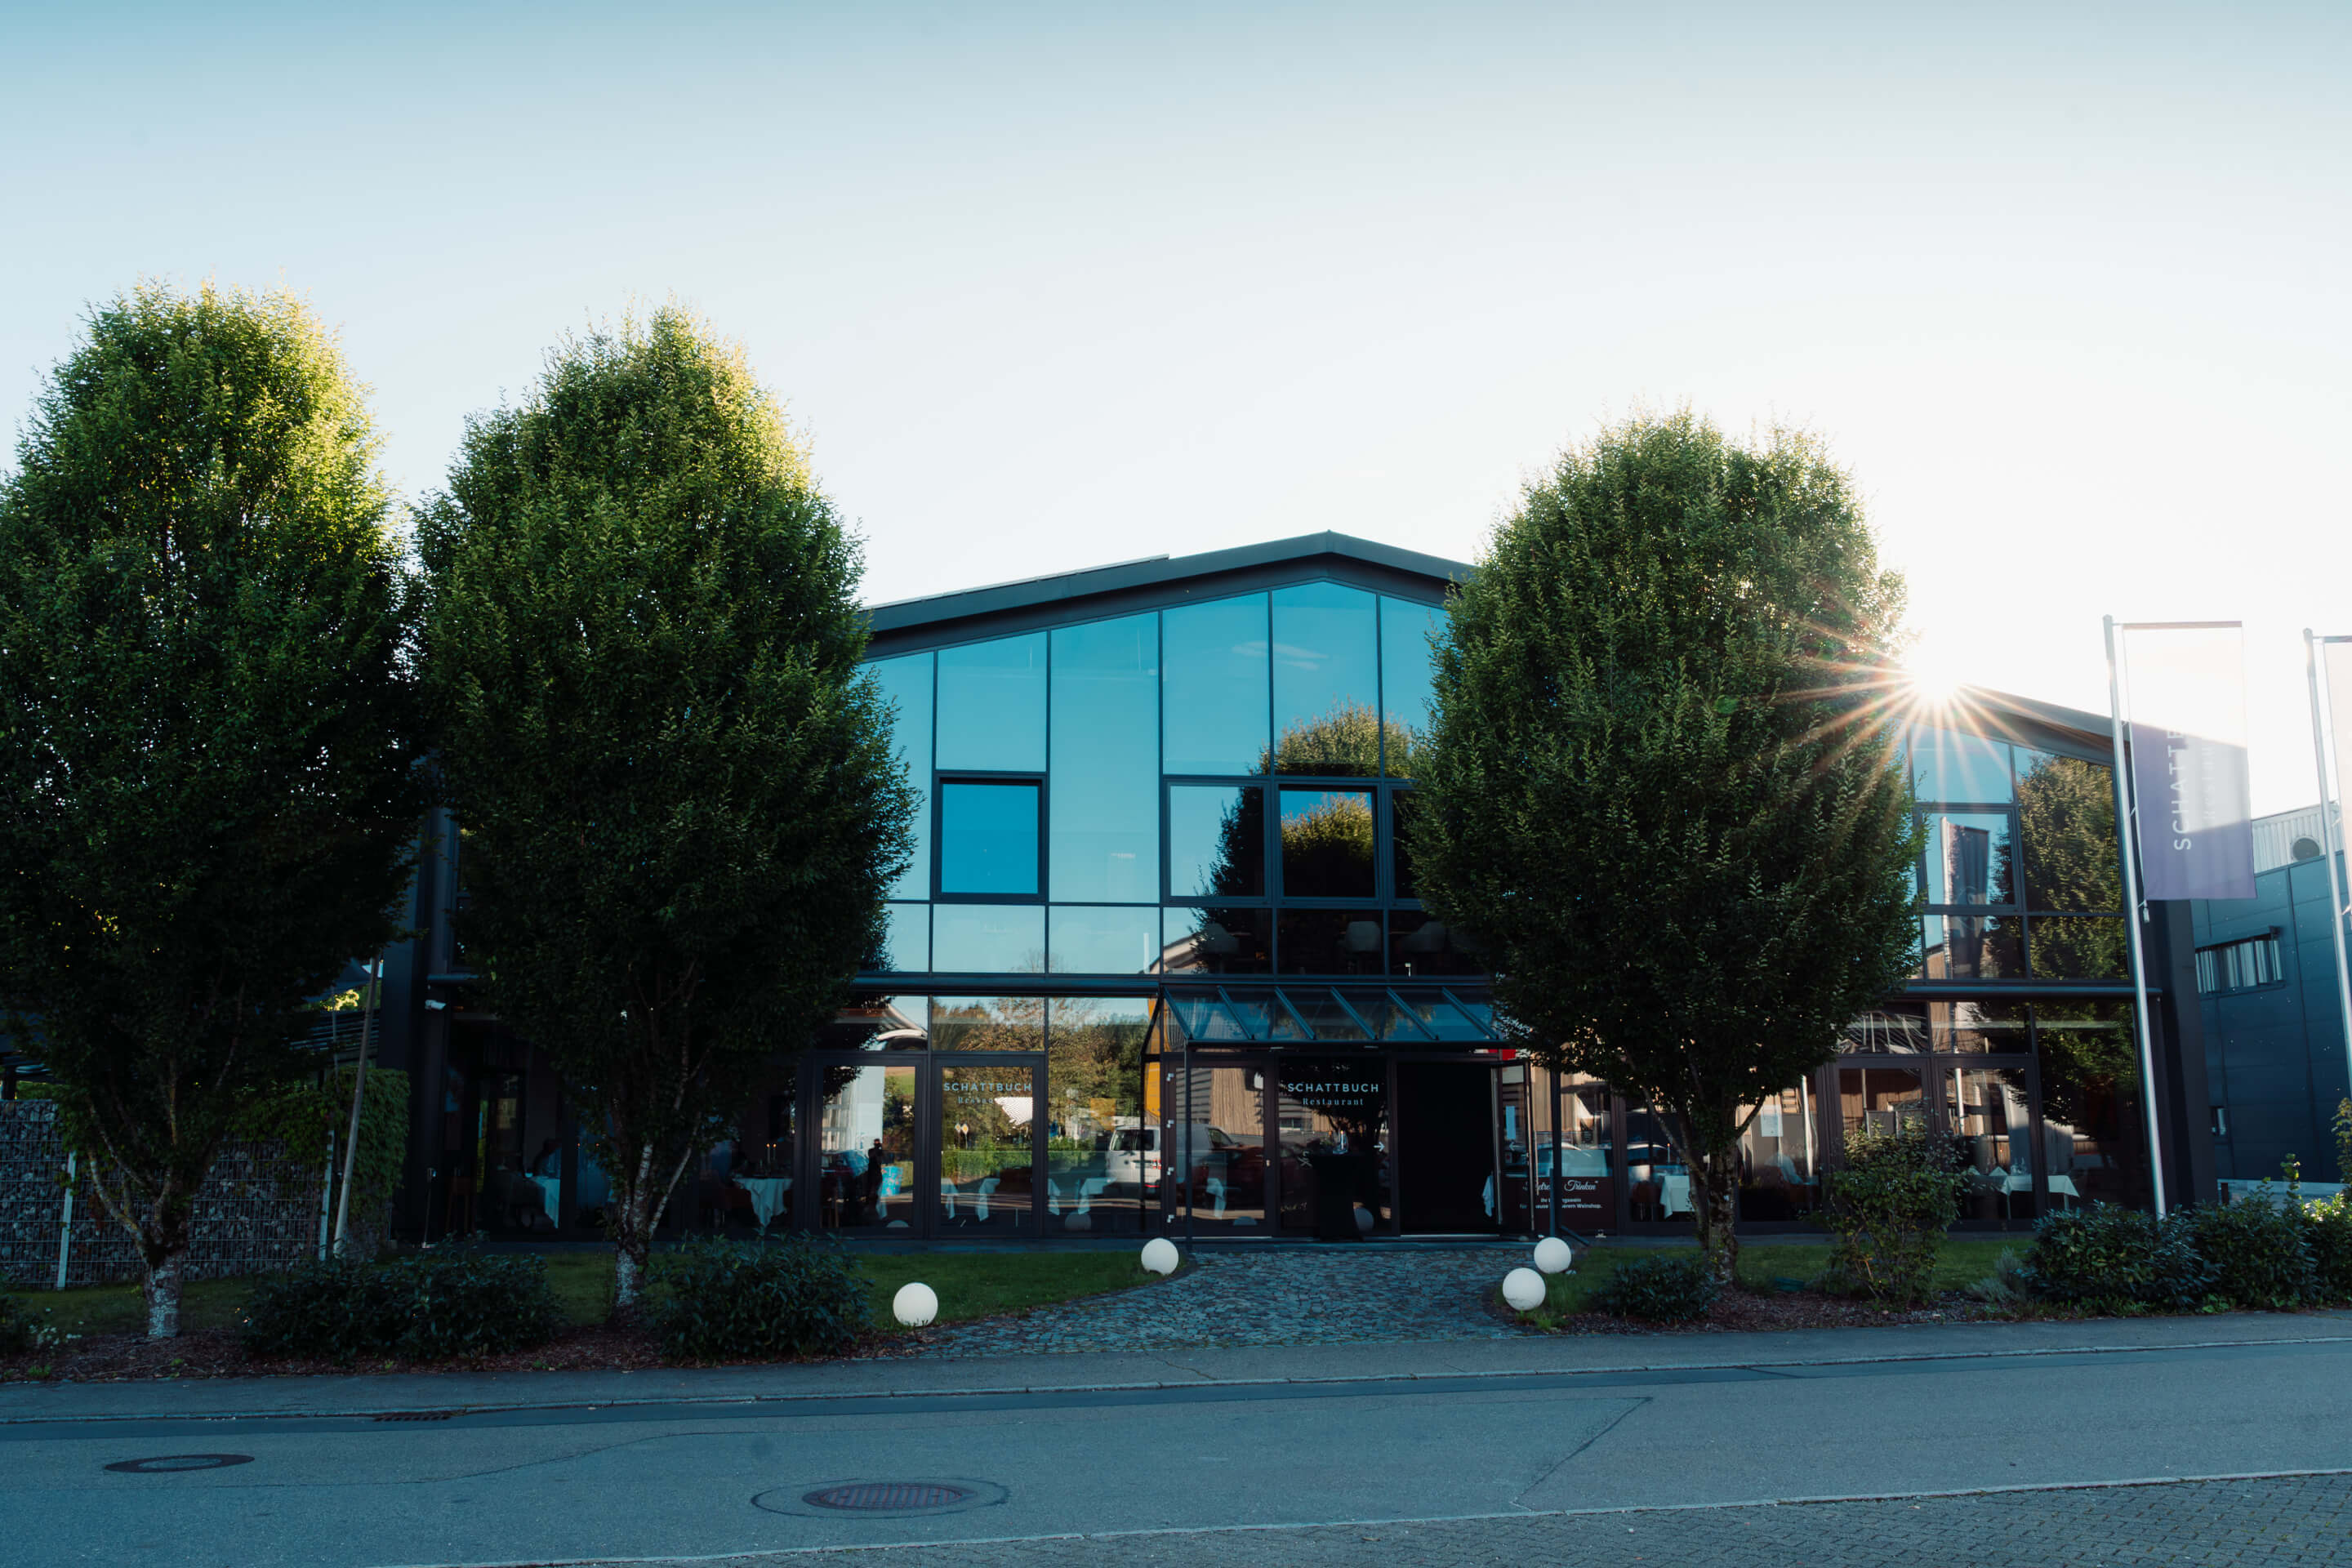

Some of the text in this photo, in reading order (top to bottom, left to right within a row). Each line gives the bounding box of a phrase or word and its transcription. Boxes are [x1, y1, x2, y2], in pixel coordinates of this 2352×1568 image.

[943, 1082, 1031, 1092] SCHATTBUCH
[1287, 1083, 1379, 1093] SCHATTBUCH
[1303, 1097, 1364, 1106] Restaurant
